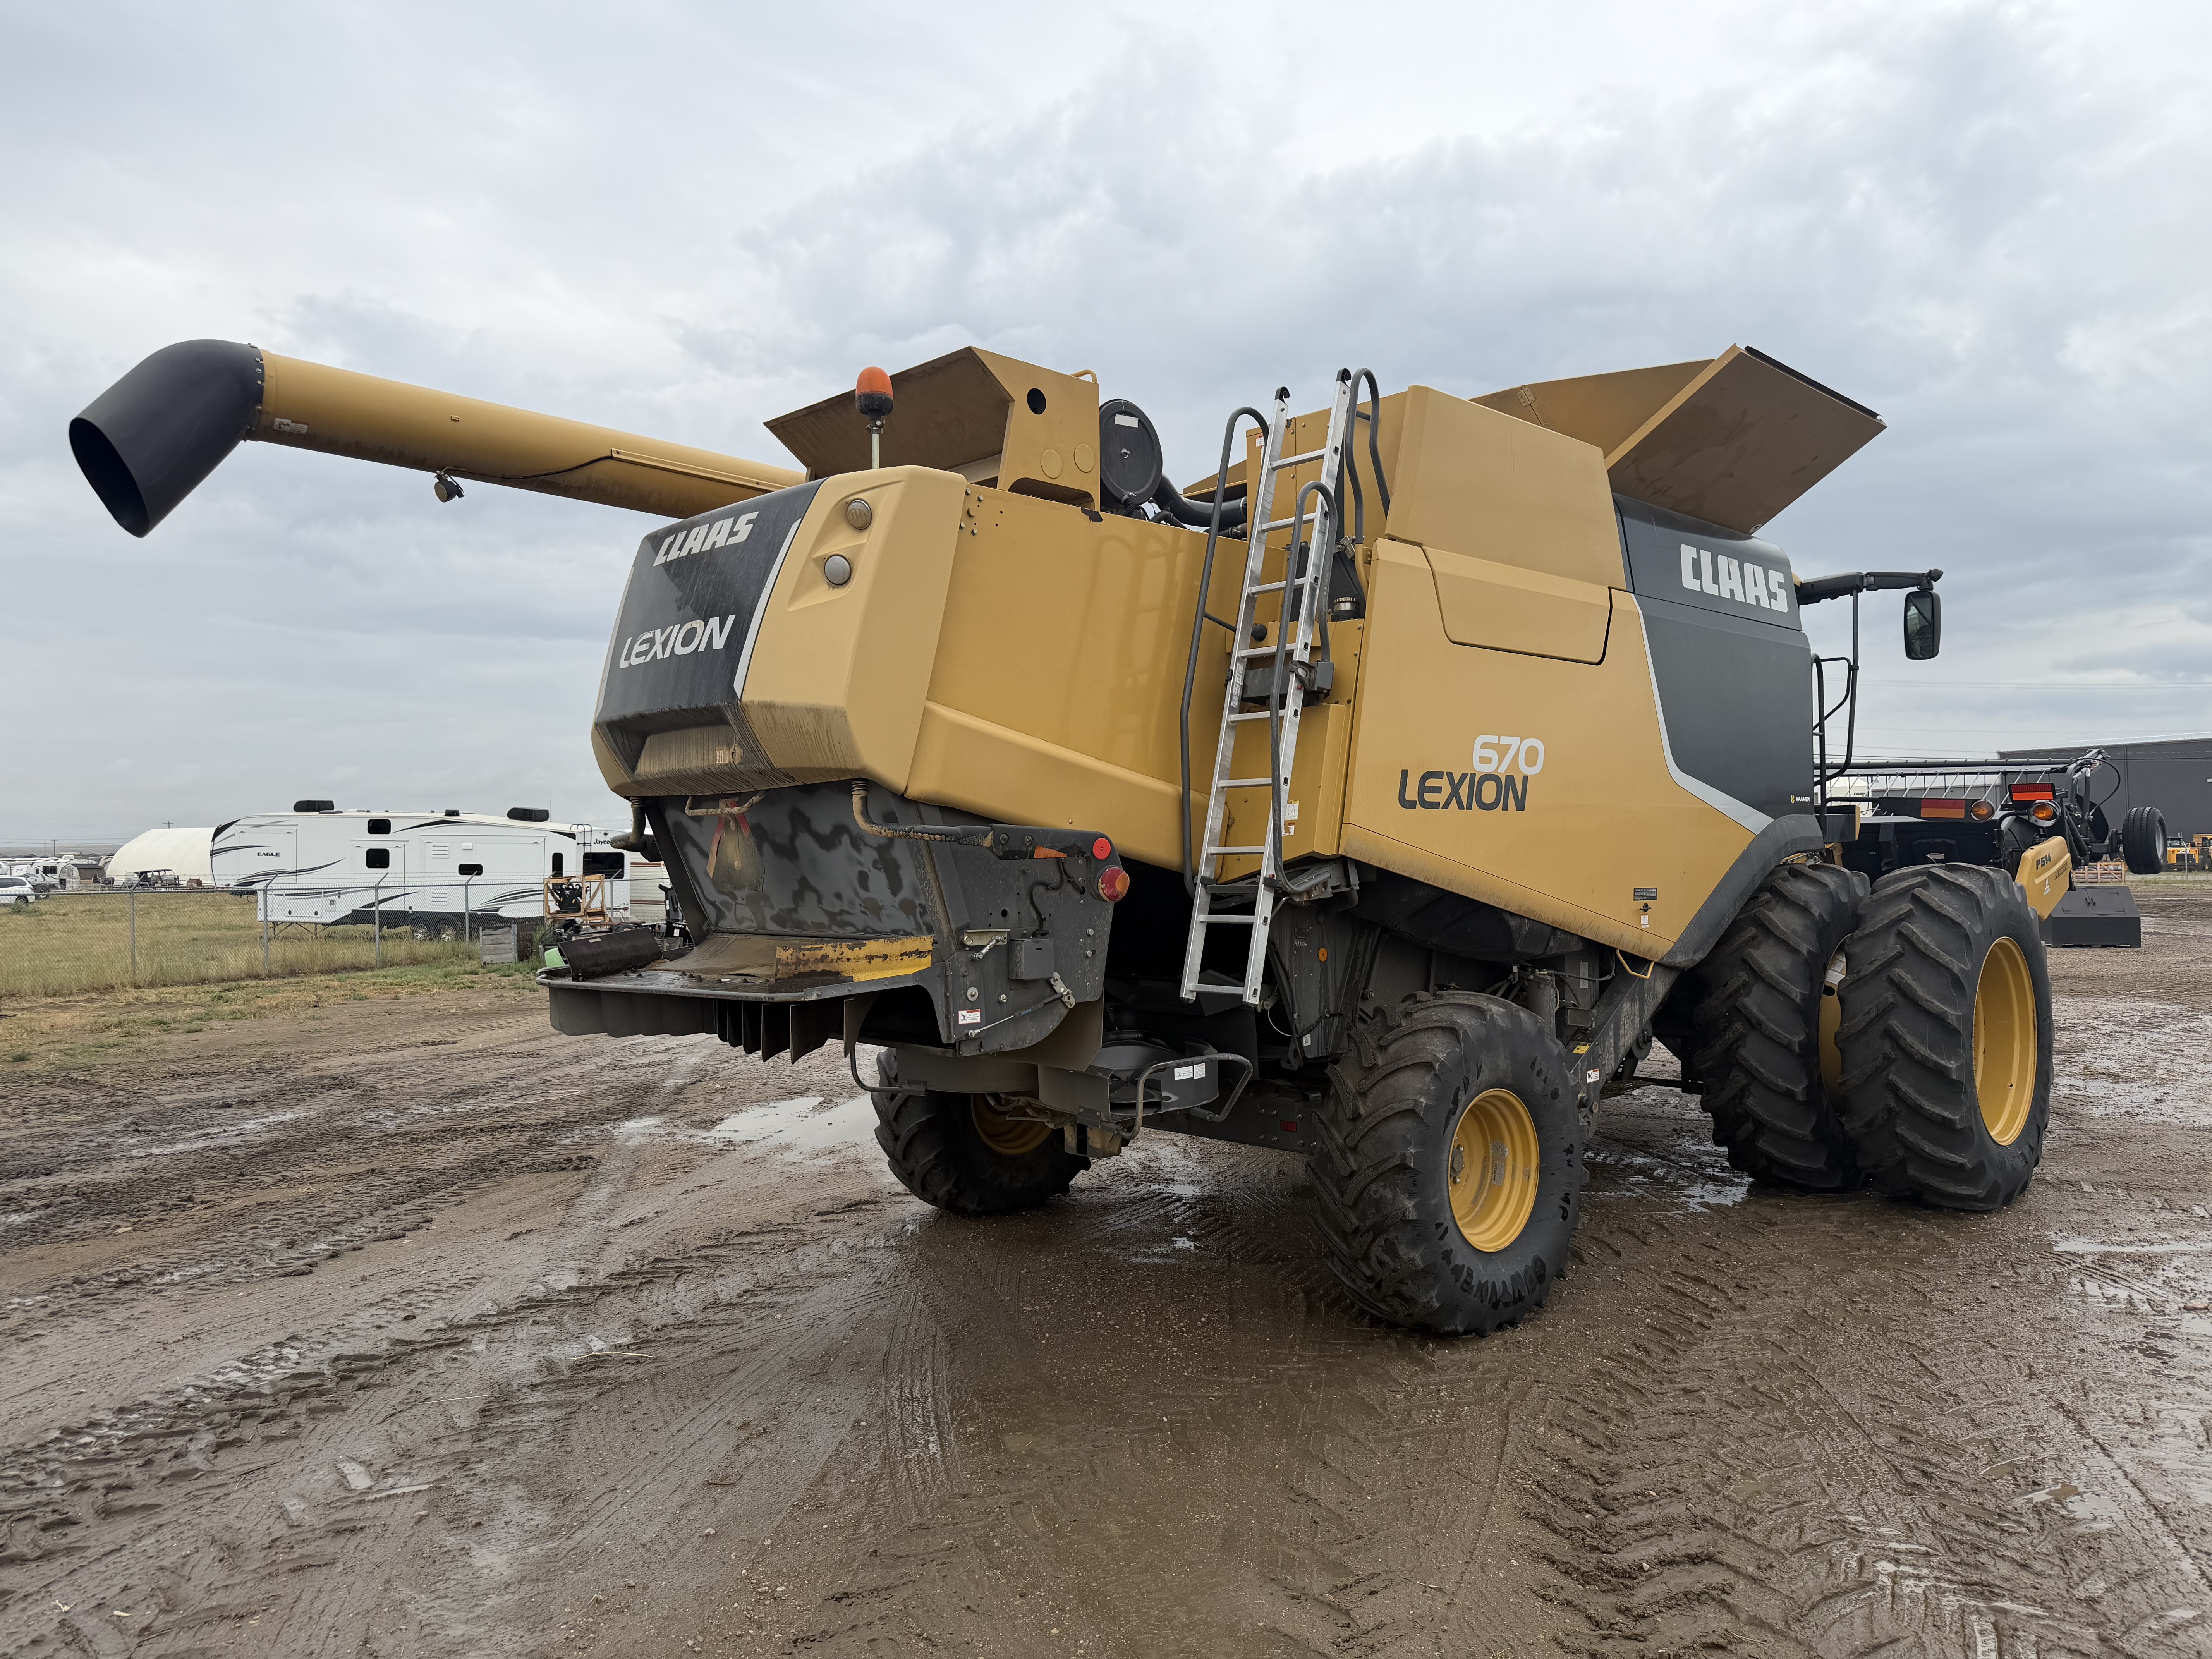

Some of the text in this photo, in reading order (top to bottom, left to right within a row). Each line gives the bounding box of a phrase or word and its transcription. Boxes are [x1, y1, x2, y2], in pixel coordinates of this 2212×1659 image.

[653, 511, 759, 567] CLAAS
[1680, 544, 1788, 613] CLAAS
[619, 614, 736, 669] LEXION
[1472, 735, 1545, 775] 670
[1398, 769, 1528, 811] LEXION
[2036, 853, 2052, 871] P514
